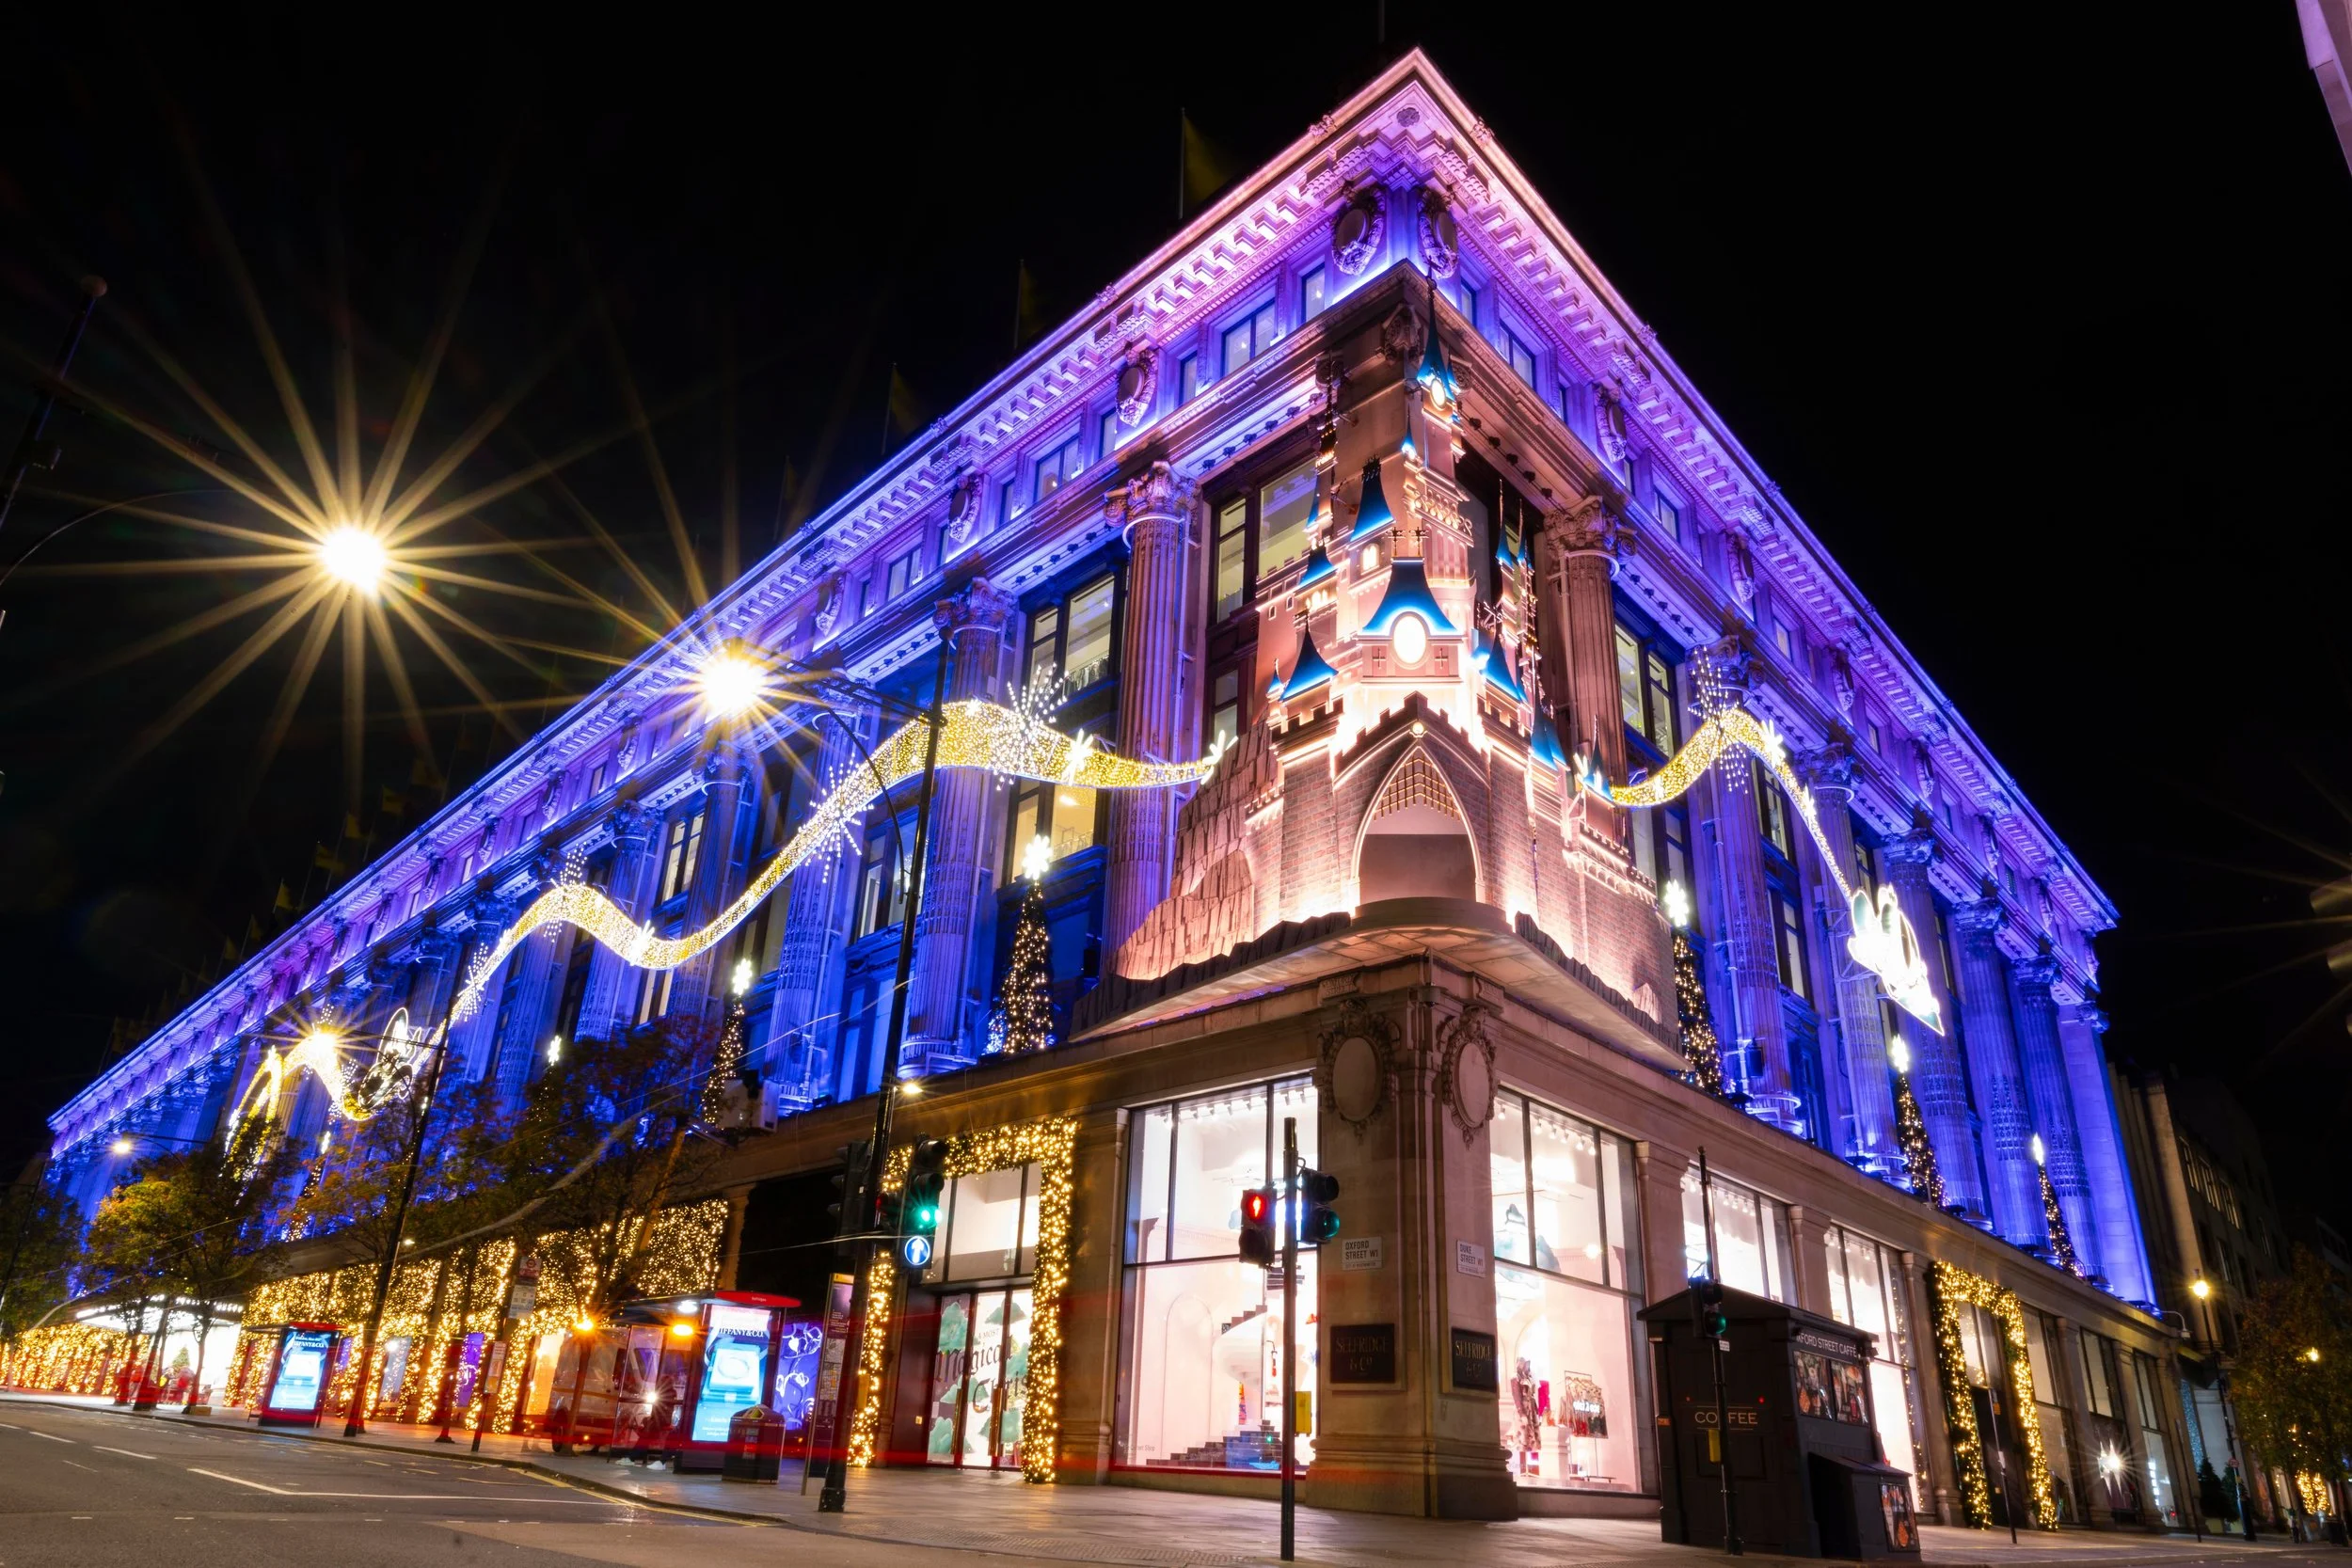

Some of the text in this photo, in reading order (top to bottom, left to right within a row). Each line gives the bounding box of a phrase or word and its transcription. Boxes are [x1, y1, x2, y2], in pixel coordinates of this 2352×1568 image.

[1345, 1241, 1370, 1250] OXFORD
[1459, 1243, 1471, 1255] DUKE
[1345, 1249, 1378, 1259] STREET W1
[1460, 1254, 1476, 1265] STREET
[1796, 1333, 1817, 1347] XFORD
[1818, 1338, 1838, 1353] STREET
[1694, 1412, 1757, 1424] COFEE
